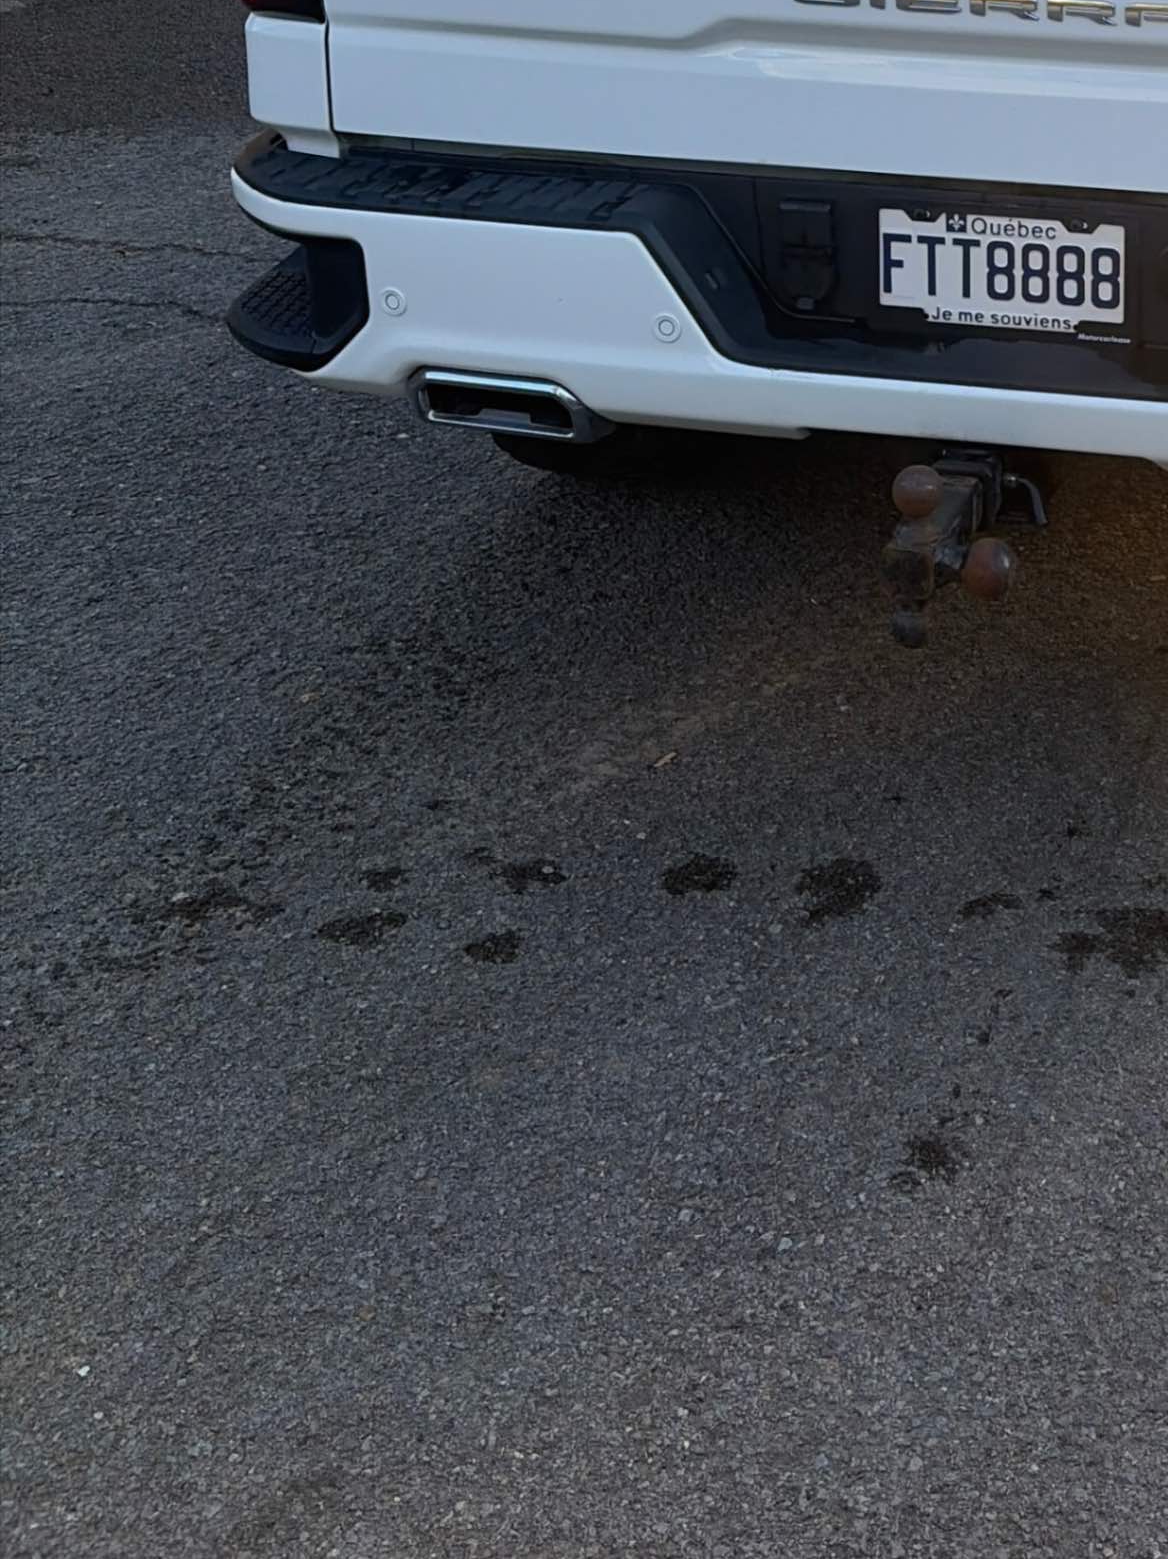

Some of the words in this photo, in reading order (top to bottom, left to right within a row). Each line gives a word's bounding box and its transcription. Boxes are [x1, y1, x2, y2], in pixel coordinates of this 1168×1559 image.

[970, 216, 1057, 241] Québec
[881, 231, 1121, 310] FTT8888
[931, 306, 953, 322] Je
[957, 309, 985, 324] me
[991, 313, 1072, 331] souviens
